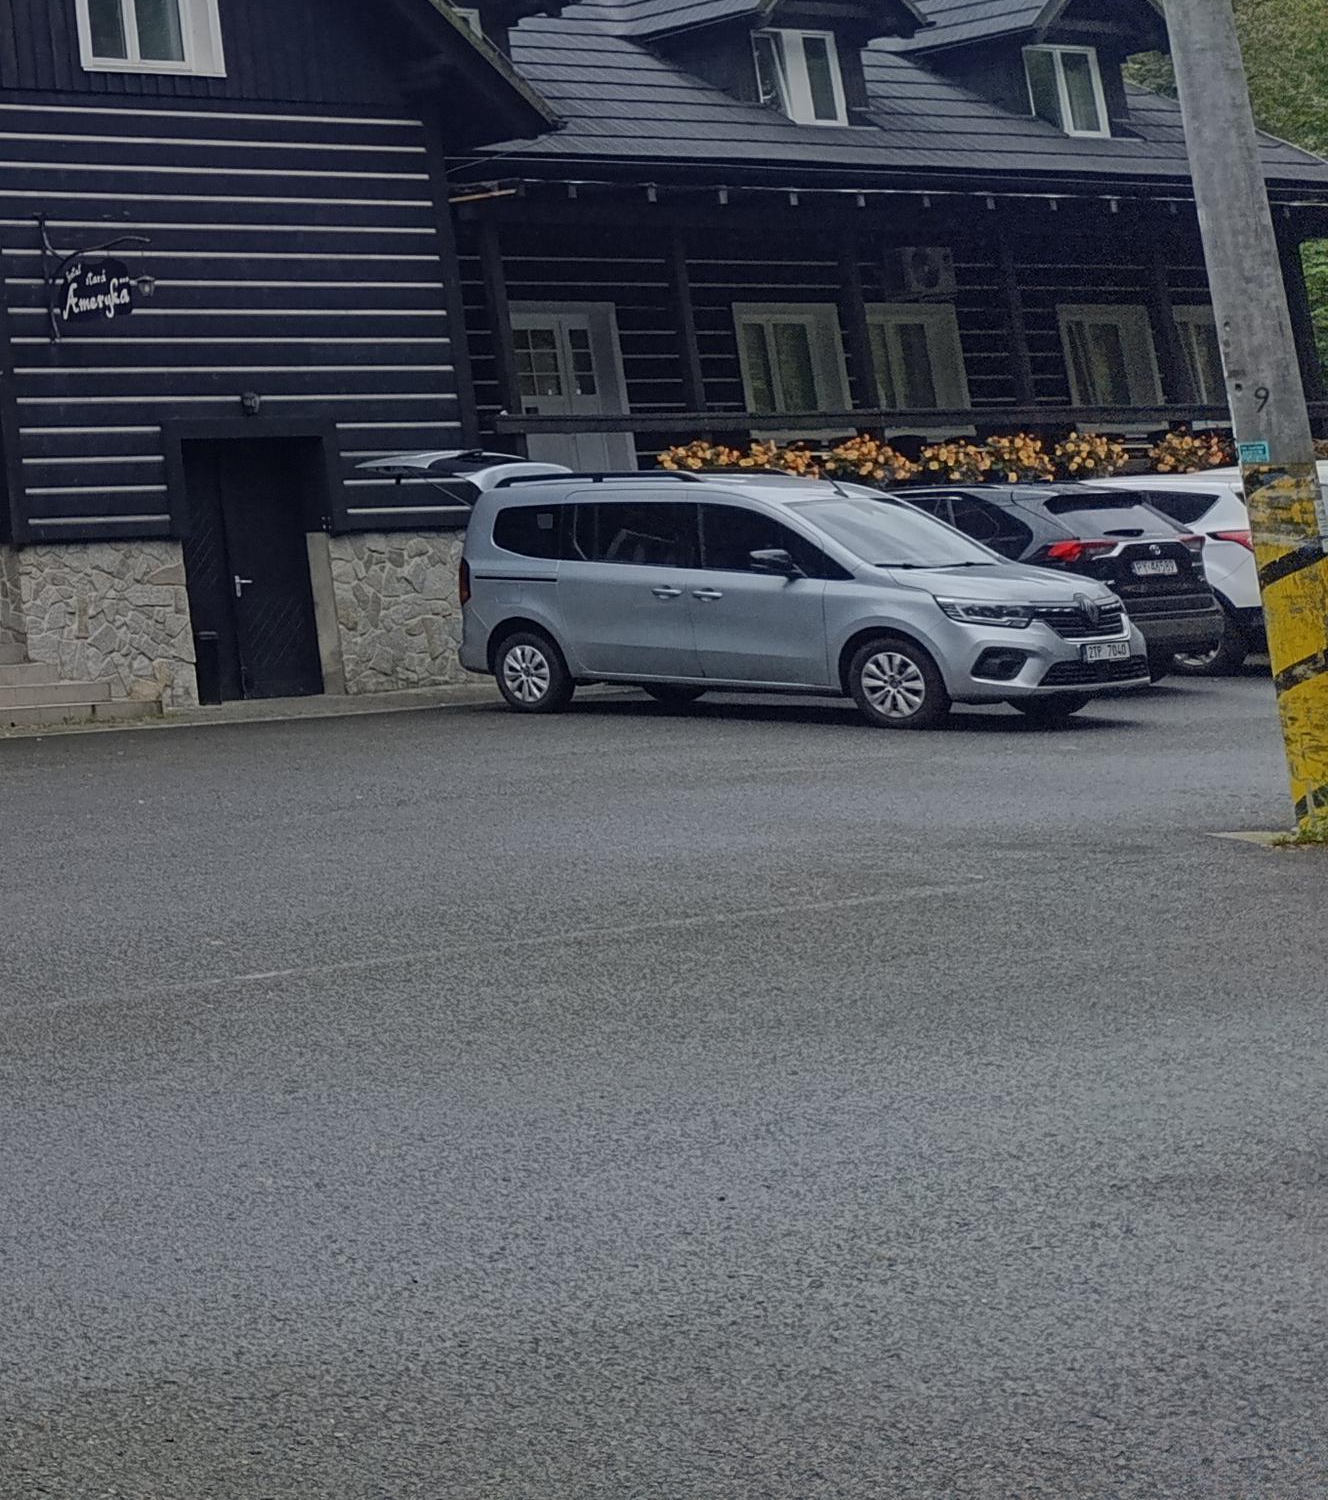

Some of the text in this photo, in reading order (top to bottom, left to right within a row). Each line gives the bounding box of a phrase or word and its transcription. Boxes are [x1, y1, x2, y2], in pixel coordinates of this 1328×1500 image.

[1254, 386, 1270, 413] 9
[1088, 643, 1127, 659] 2TP 7040
